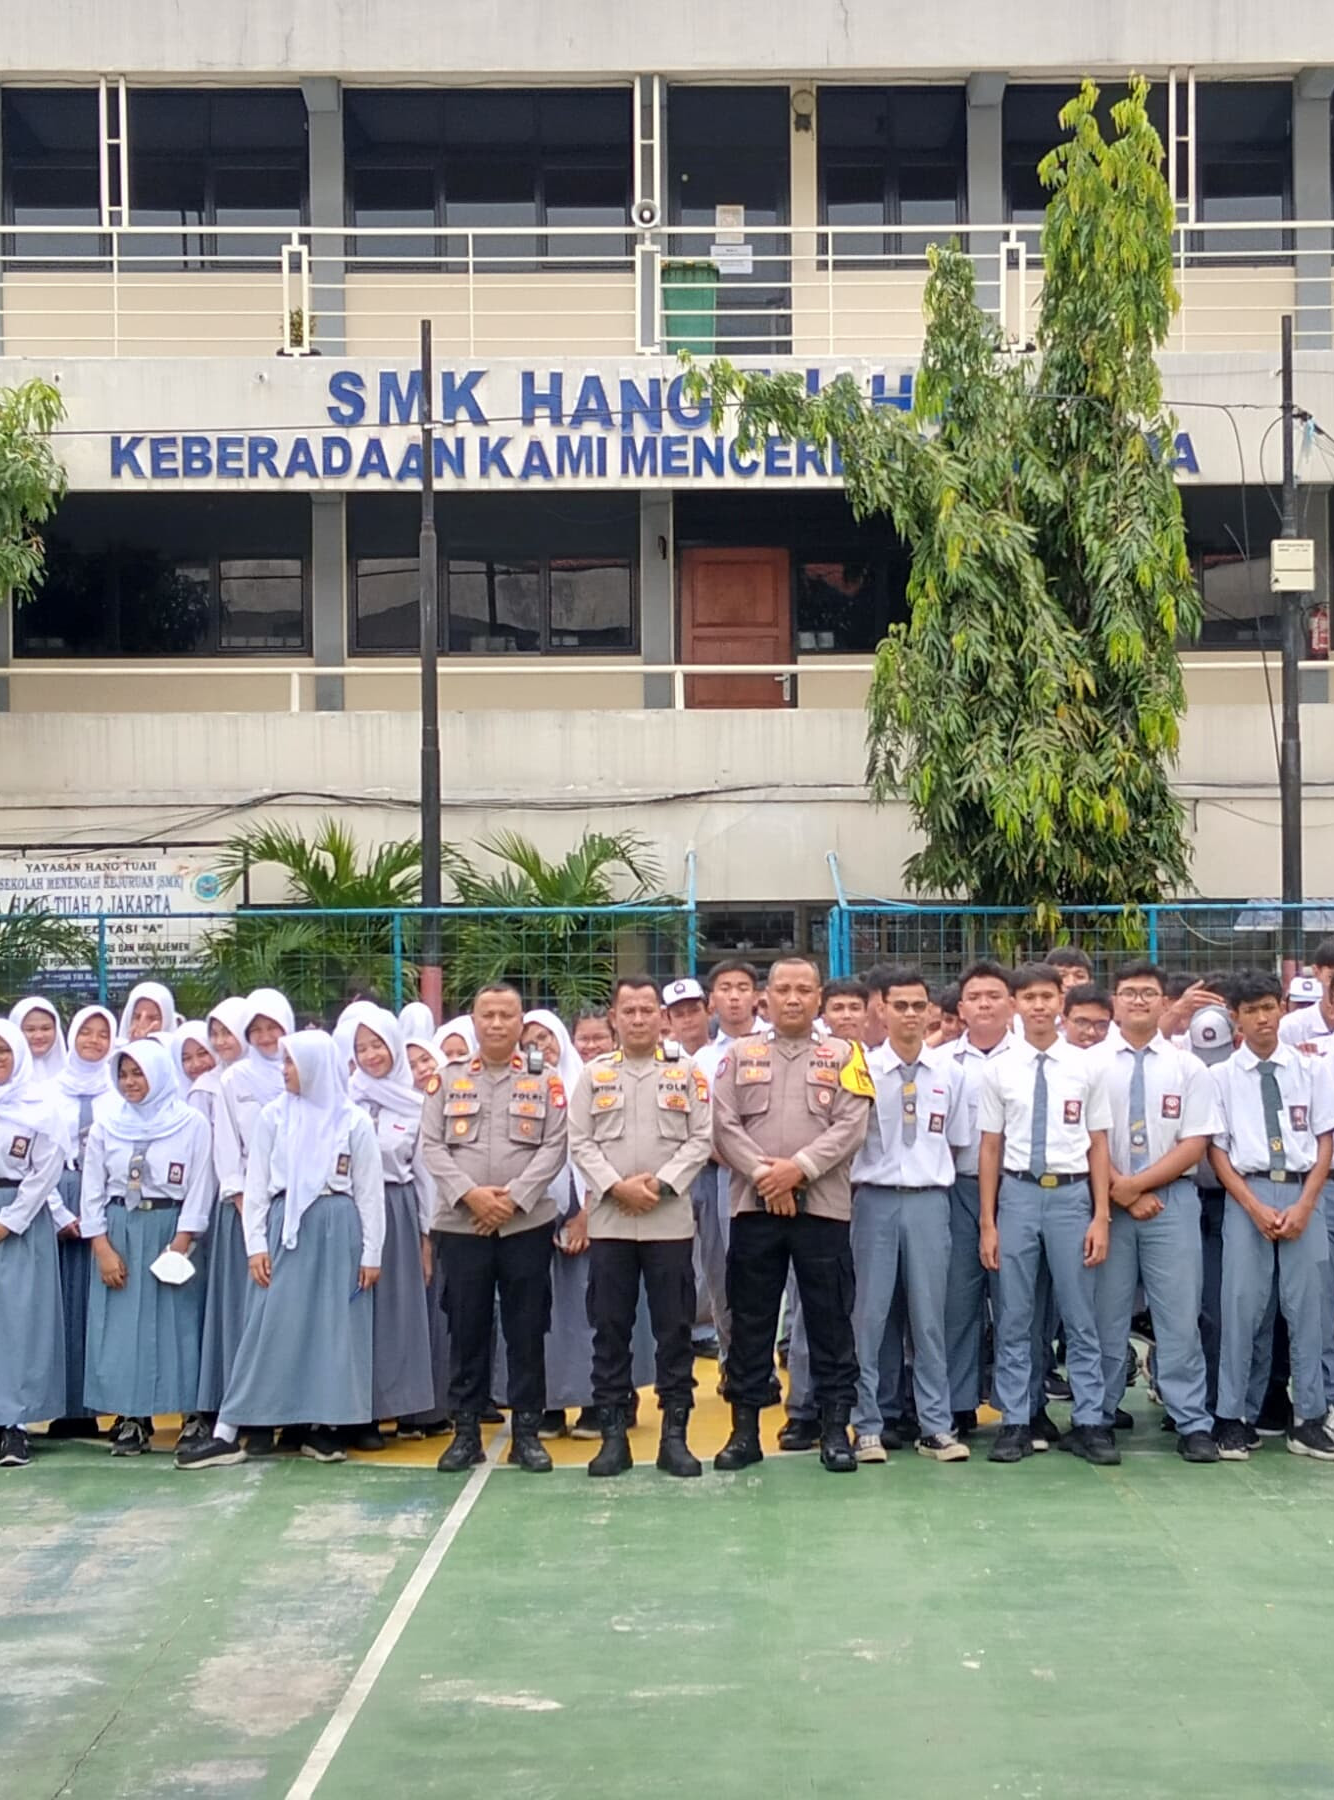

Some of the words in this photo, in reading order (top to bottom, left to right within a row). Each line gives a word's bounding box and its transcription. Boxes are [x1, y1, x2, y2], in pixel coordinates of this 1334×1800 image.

[327, 369, 488, 427] SMK
[520, 369, 713, 434] HANG
[110, 434, 465, 483] KEBERADAAN
[478, 434, 608, 482] KAMI
[25, 863, 81, 873] YAYASAN
[85, 862, 120, 872] HANG
[123, 861, 157, 872] TUAH
[46, 875, 101, 890] MENENGAH
[53, 895, 92, 914] TUAH
[95, 895, 104, 914] 2
[107, 894, 172, 915] JAKARTA
